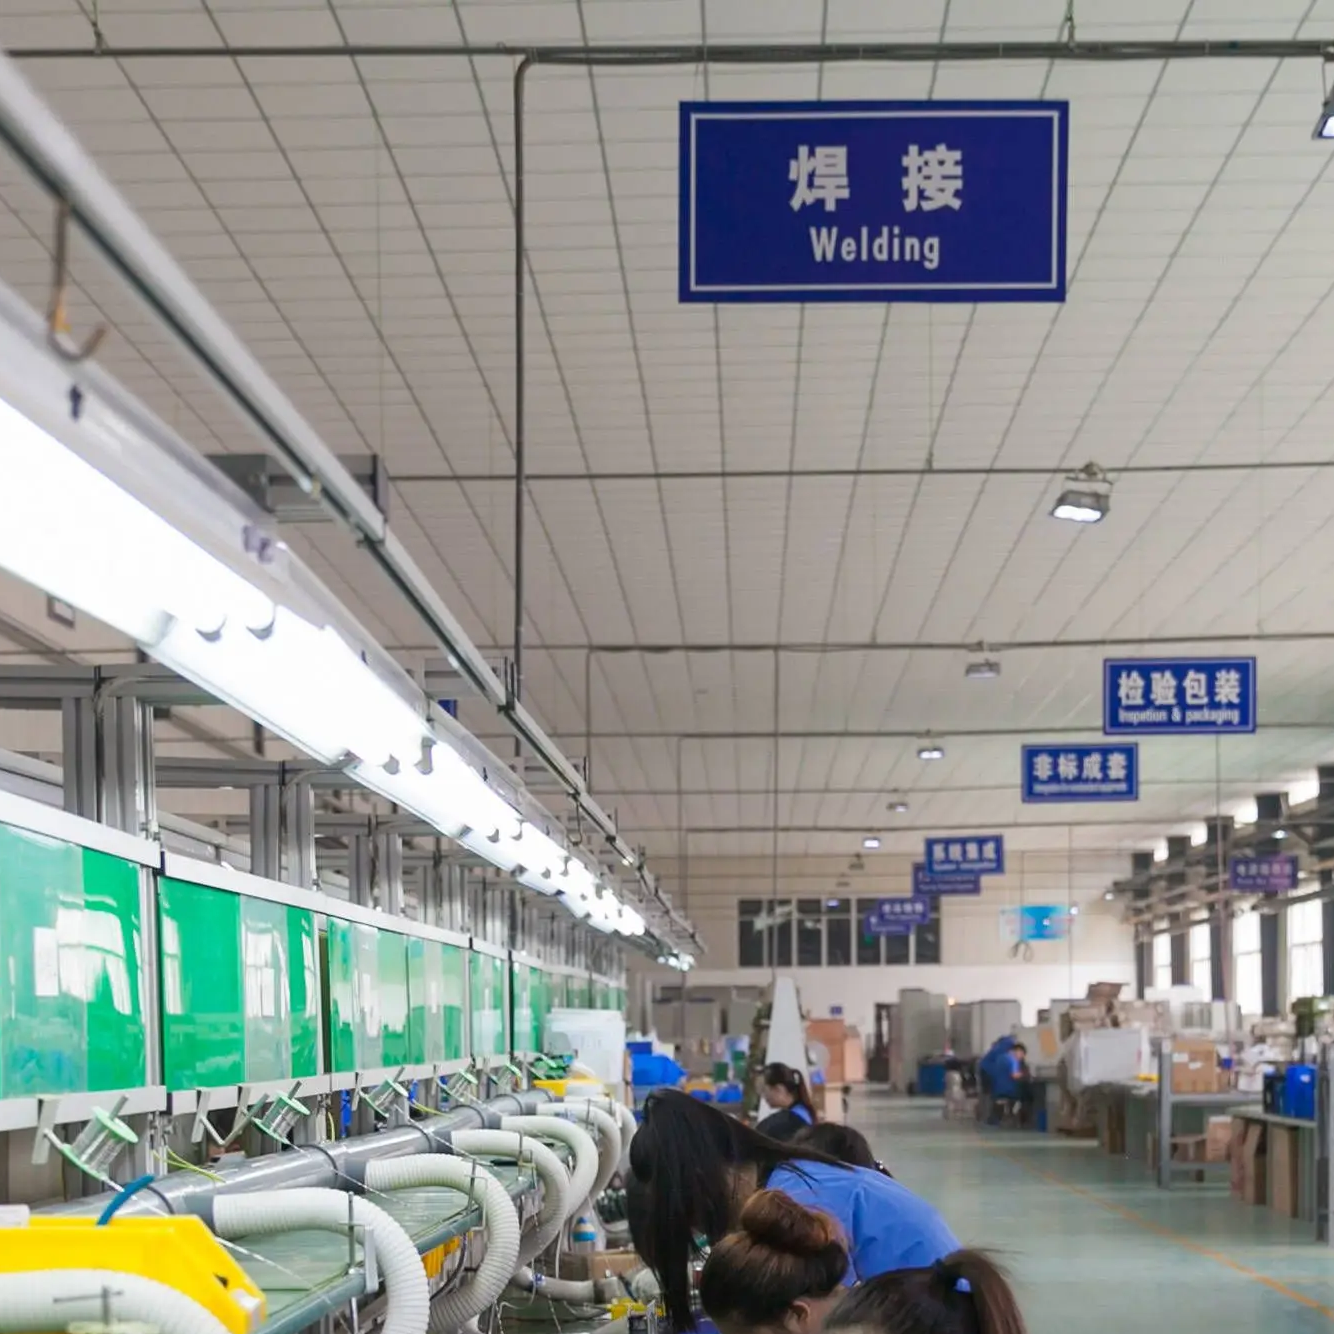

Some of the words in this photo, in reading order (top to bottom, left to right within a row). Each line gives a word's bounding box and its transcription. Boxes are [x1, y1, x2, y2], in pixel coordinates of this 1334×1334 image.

[788, 144, 964, 212] 焊接
[809, 226, 940, 270] Welding
[1117, 668, 1241, 706] 检验包装
[1032, 751, 1128, 781] 非标成套
